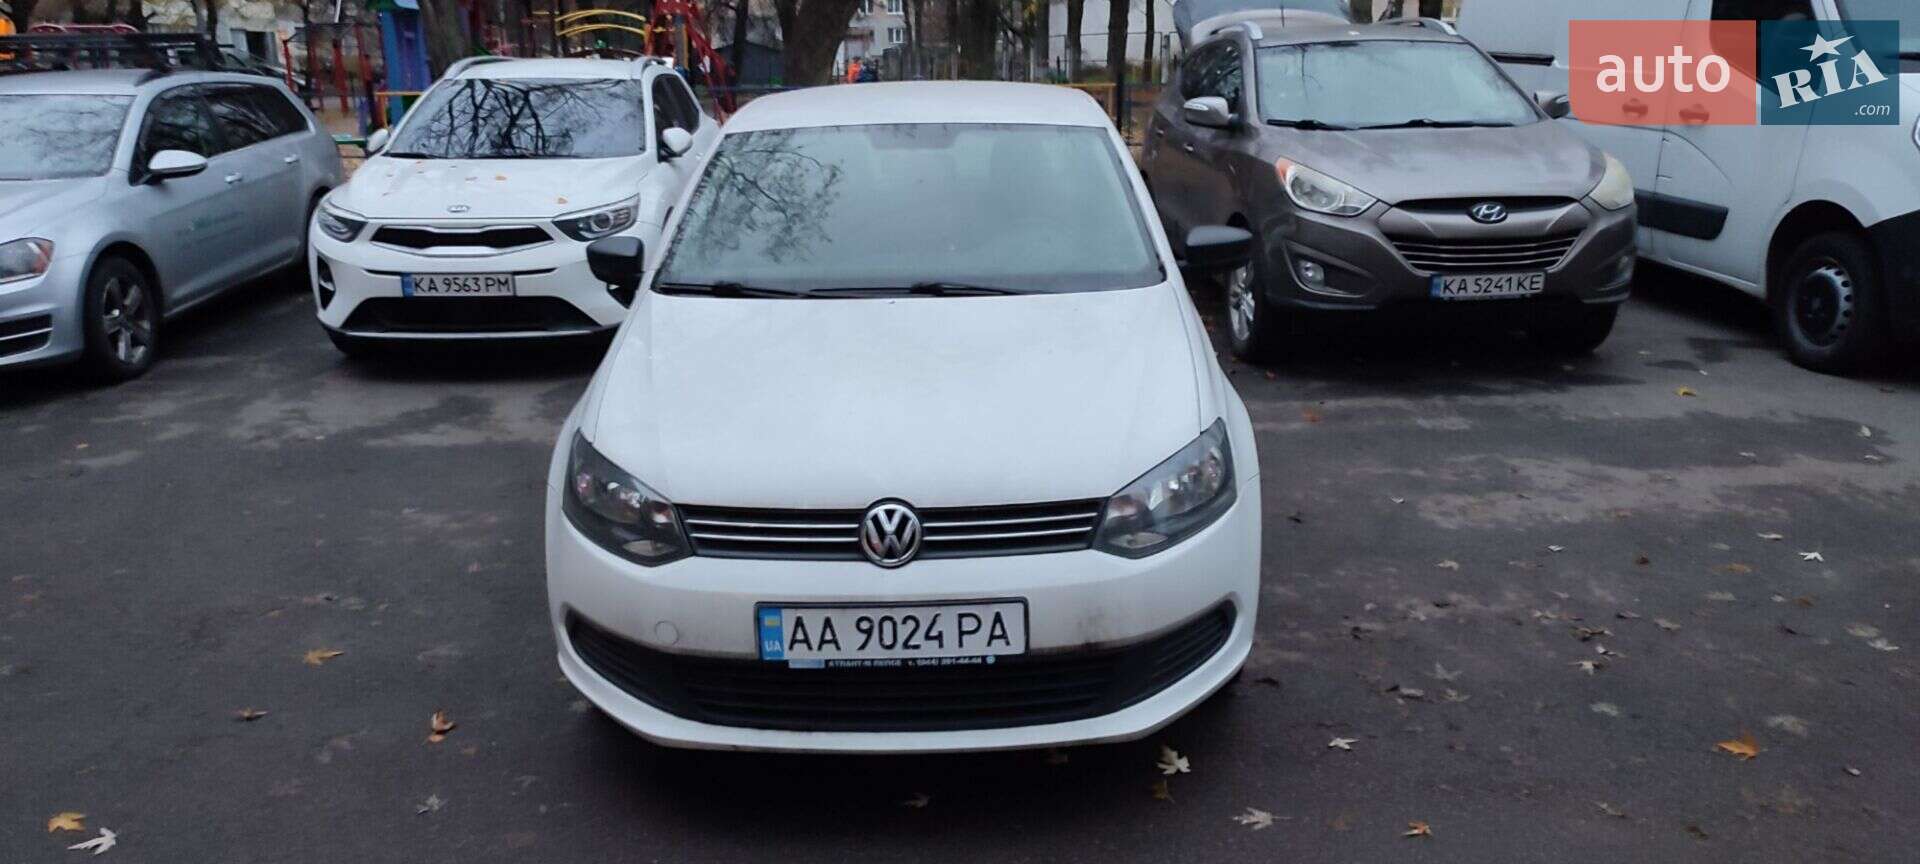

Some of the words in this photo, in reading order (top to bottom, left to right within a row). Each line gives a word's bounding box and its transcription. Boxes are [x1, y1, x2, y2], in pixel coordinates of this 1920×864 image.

[414, 278, 438, 293] KA
[442, 277, 480, 293] 9563
[484, 277, 510, 292] PM
[1443, 279, 1468, 294] KA
[1473, 277, 1512, 293] 5241
[1517, 275, 1541, 291] KE
[788, 616, 841, 651] AA
[855, 613, 944, 650] 9024
[957, 611, 1010, 648] PA
[764, 639, 782, 651] UA
